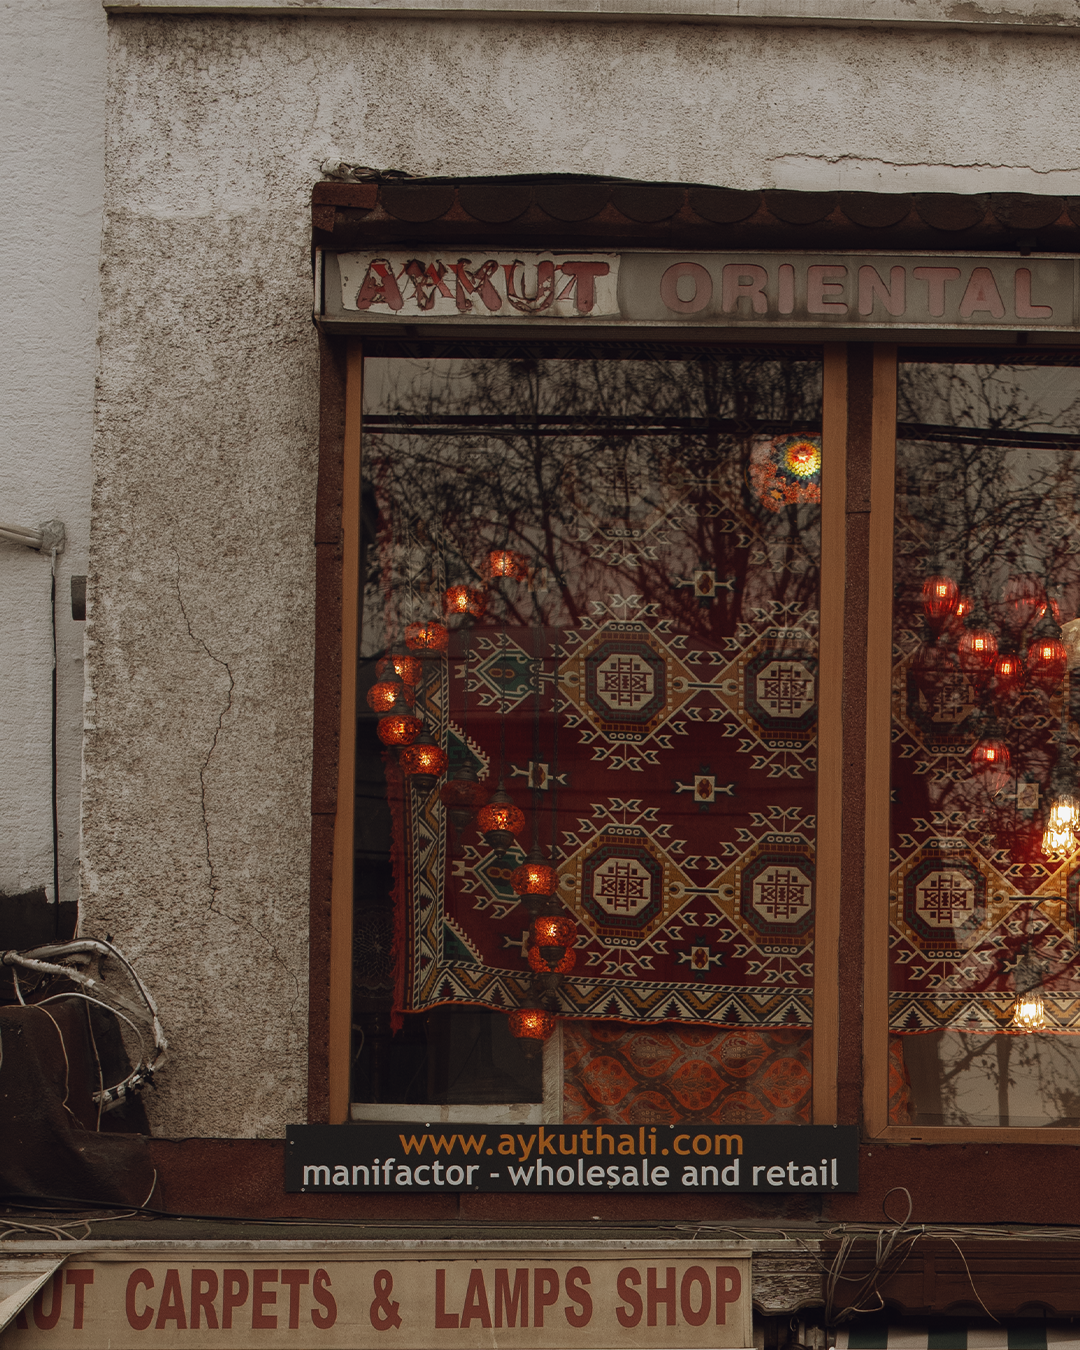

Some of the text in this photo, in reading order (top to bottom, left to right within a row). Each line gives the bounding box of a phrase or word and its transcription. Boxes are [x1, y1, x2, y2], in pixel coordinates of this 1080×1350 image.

[355, 257, 609, 314] AYKUT
[660, 261, 1053, 319] ORIENTAL
[400, 1127, 744, 1162] www.aykuthali.com
[303, 1157, 480, 1187] manifactor
[508, 1158, 670, 1187] wholesale
[682, 1158, 740, 1187] and
[753, 1157, 839, 1188] retail
[125, 1268, 338, 1331] CARPETS
[369, 1268, 403, 1332] &
[434, 1266, 593, 1330] LAMPS
[615, 1265, 743, 1328] SHOP
